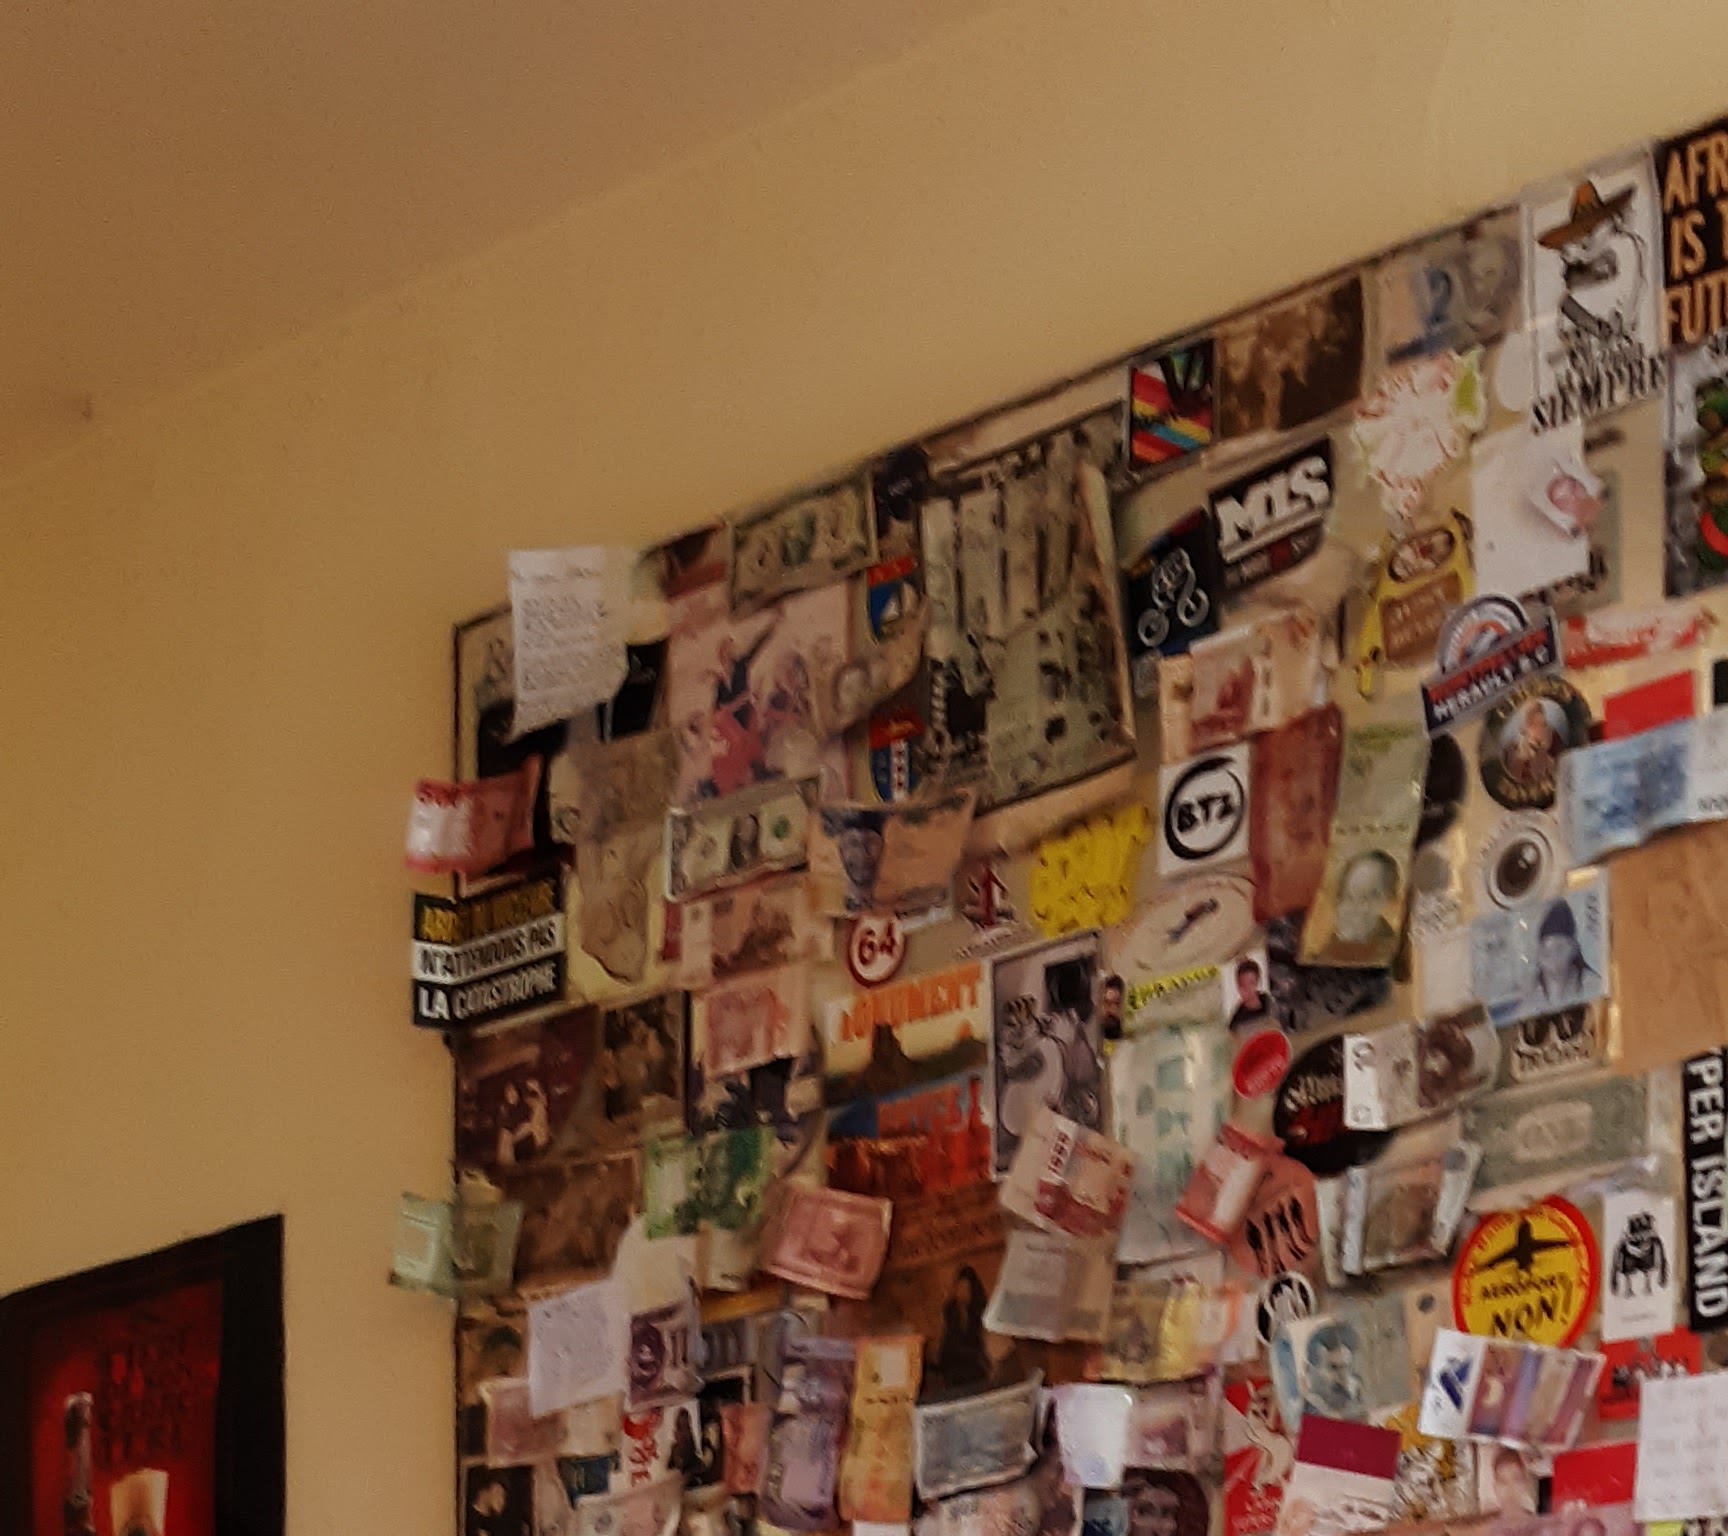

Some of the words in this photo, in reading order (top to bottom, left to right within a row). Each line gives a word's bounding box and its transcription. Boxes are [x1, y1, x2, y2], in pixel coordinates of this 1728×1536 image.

[1669, 209, 1707, 280] IS
[418, 985, 450, 1021] LA
[1686, 1057, 1727, 1142] PER
